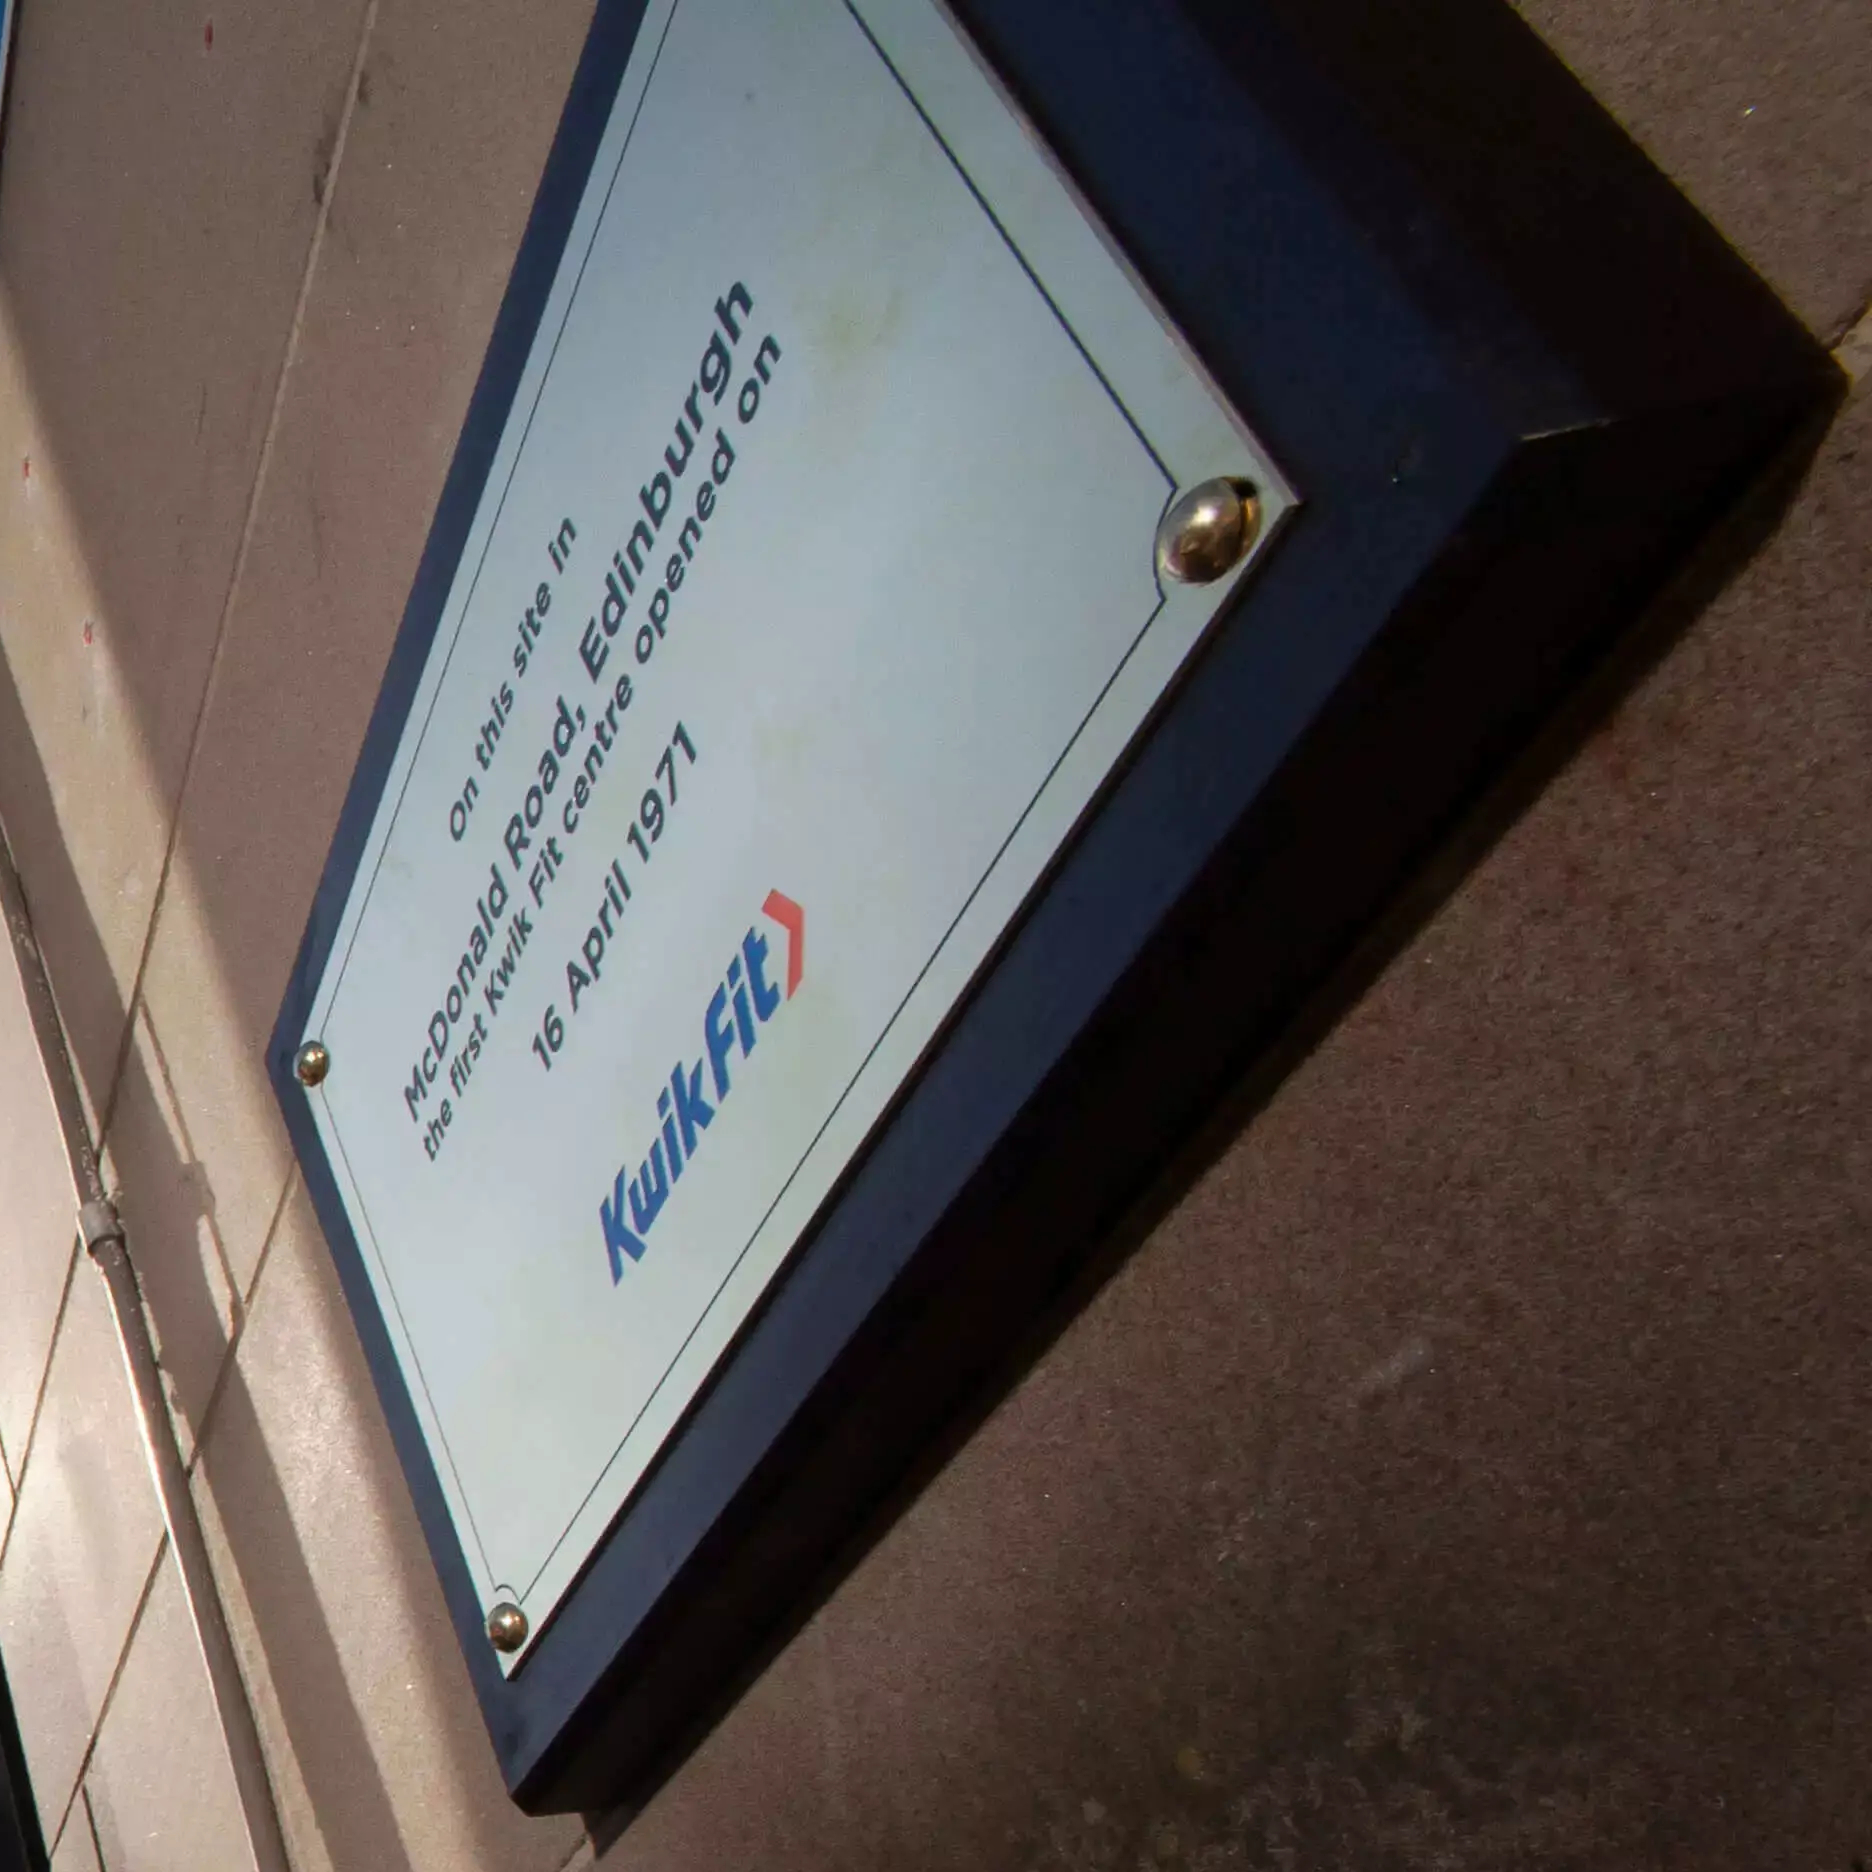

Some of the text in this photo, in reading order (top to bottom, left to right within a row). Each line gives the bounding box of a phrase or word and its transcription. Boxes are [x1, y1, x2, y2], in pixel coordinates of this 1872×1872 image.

[404, 281, 754, 1123] McDonald Road, Edinburgh
[423, 334, 782, 1162] the first Kwik Fit centre opened on
[449, 518, 577, 842] On this site in
[532, 719, 698, 1072] 16 April 1971
